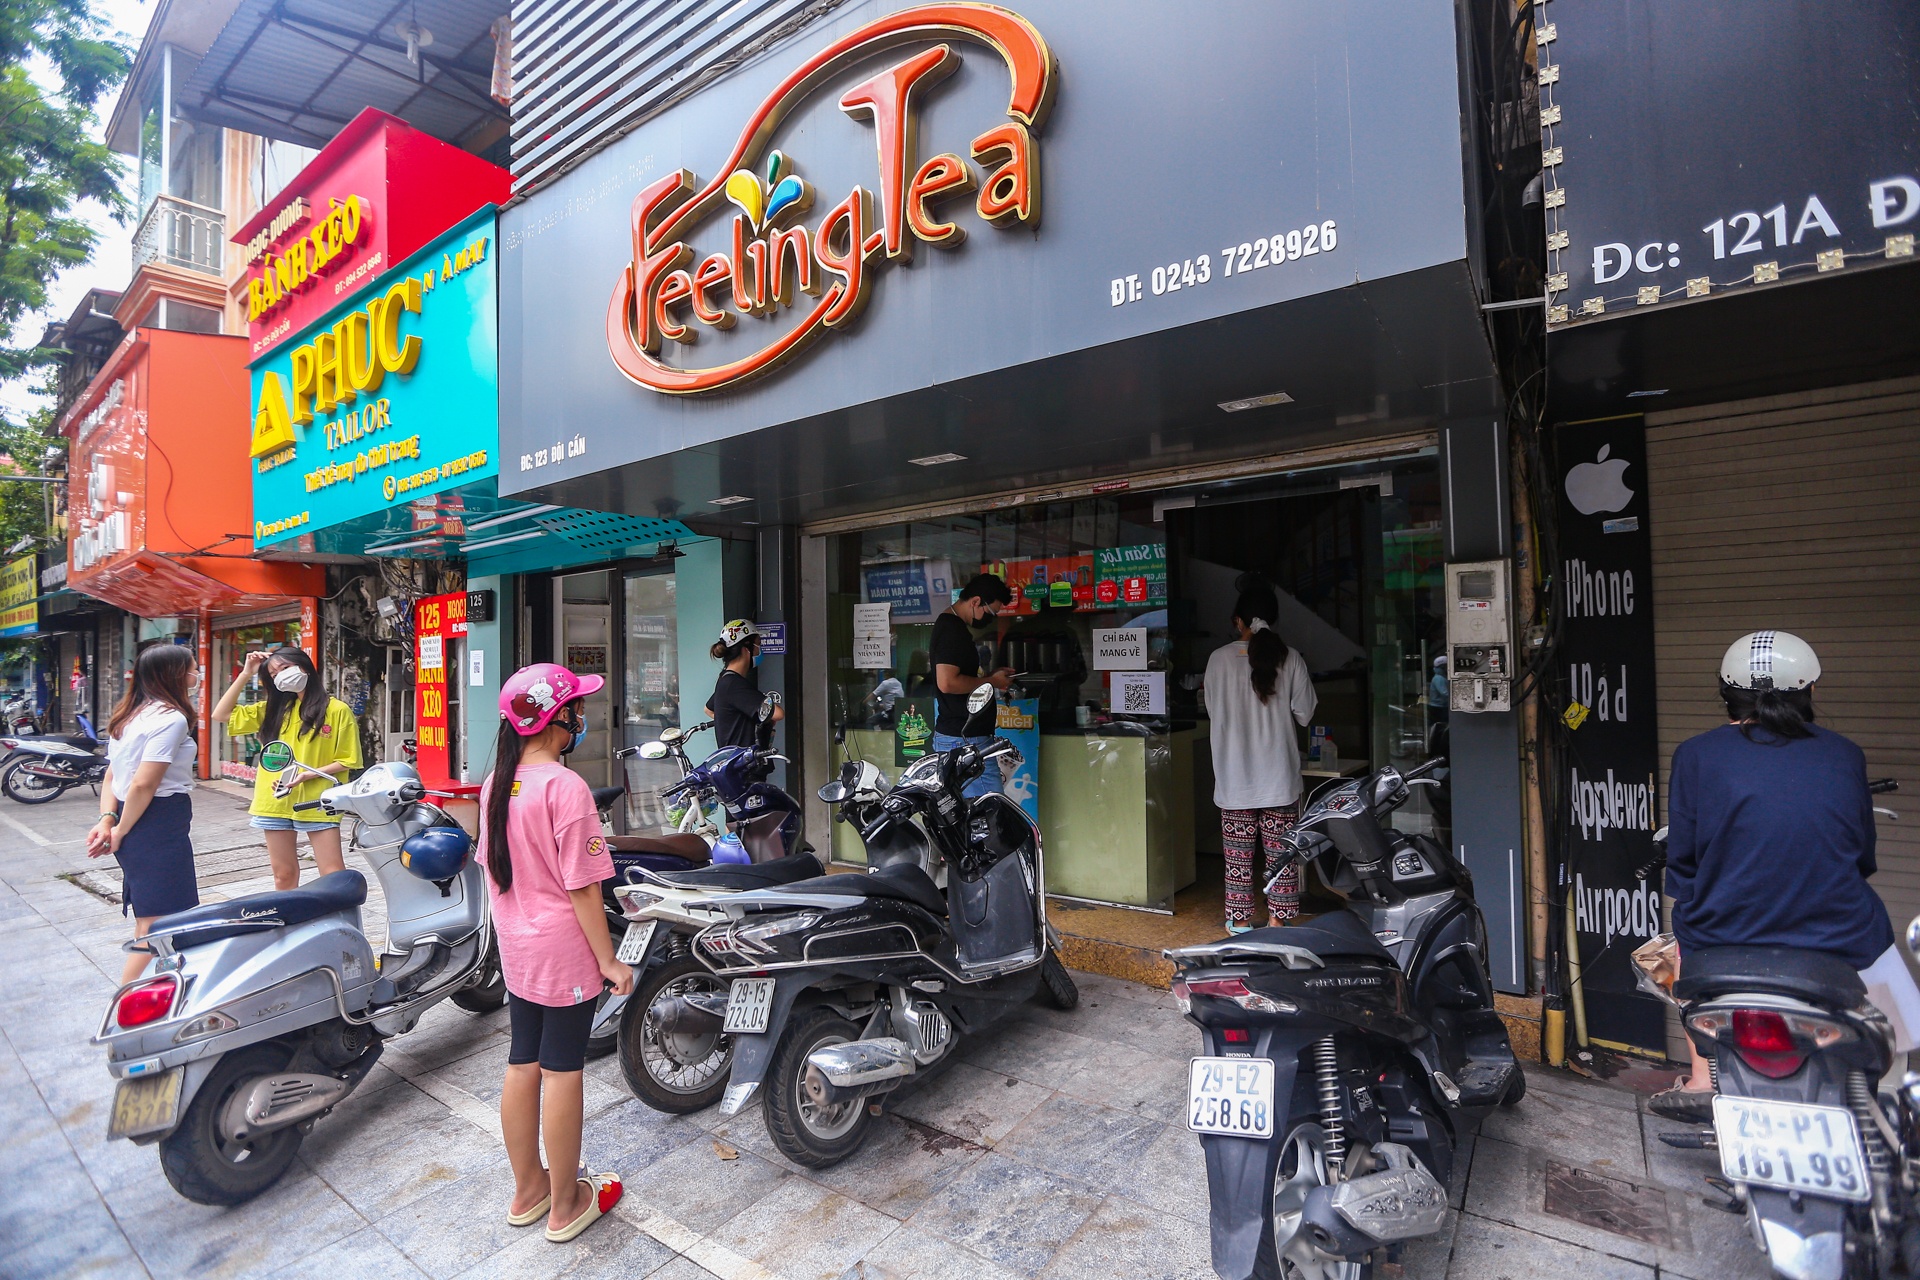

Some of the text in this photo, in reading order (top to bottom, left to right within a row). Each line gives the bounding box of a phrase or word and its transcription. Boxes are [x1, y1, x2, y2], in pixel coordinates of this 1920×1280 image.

[630, 167, 866, 352] Feeling
[838, 43, 1034, 260] Tea
[1592, 242, 1680, 284] Đc:
[1703, 195, 1841, 260] 121A
[249, 193, 361, 322] BÁNH XÈO
[1110, 219, 1338, 307] ĐT: 0243 7228926
[290, 277, 423, 425] PHUC
[323, 397, 393, 450] TAILOR
[534, 448, 548, 468] 123
[551, 441, 565, 465] ĐỘI
[567, 433, 586, 458] CẤN
[419, 603, 441, 630] 125
[447, 599, 463, 622] NGỌC
[469, 595, 483, 607] 125
[872, 649, 886, 657] VIÊN
[1100, 646, 1141, 657] MANG VỀ
[1102, 632, 1137, 643] CHỈ BÁN
[422, 684, 442, 718] XÈO
[434, 726, 445, 750] LỤI
[1002, 716, 1033, 728] HIGH
[735, 982, 768, 1004] 29-Y5
[727, 1006, 765, 1028] 724.04
[1200, 1063, 1260, 1095] 29-E2
[1193, 1096, 1267, 1132] 258.68
[1732, 1103, 1833, 1149] 29-P1
[1731, 1141, 1858, 1192] 161.99
